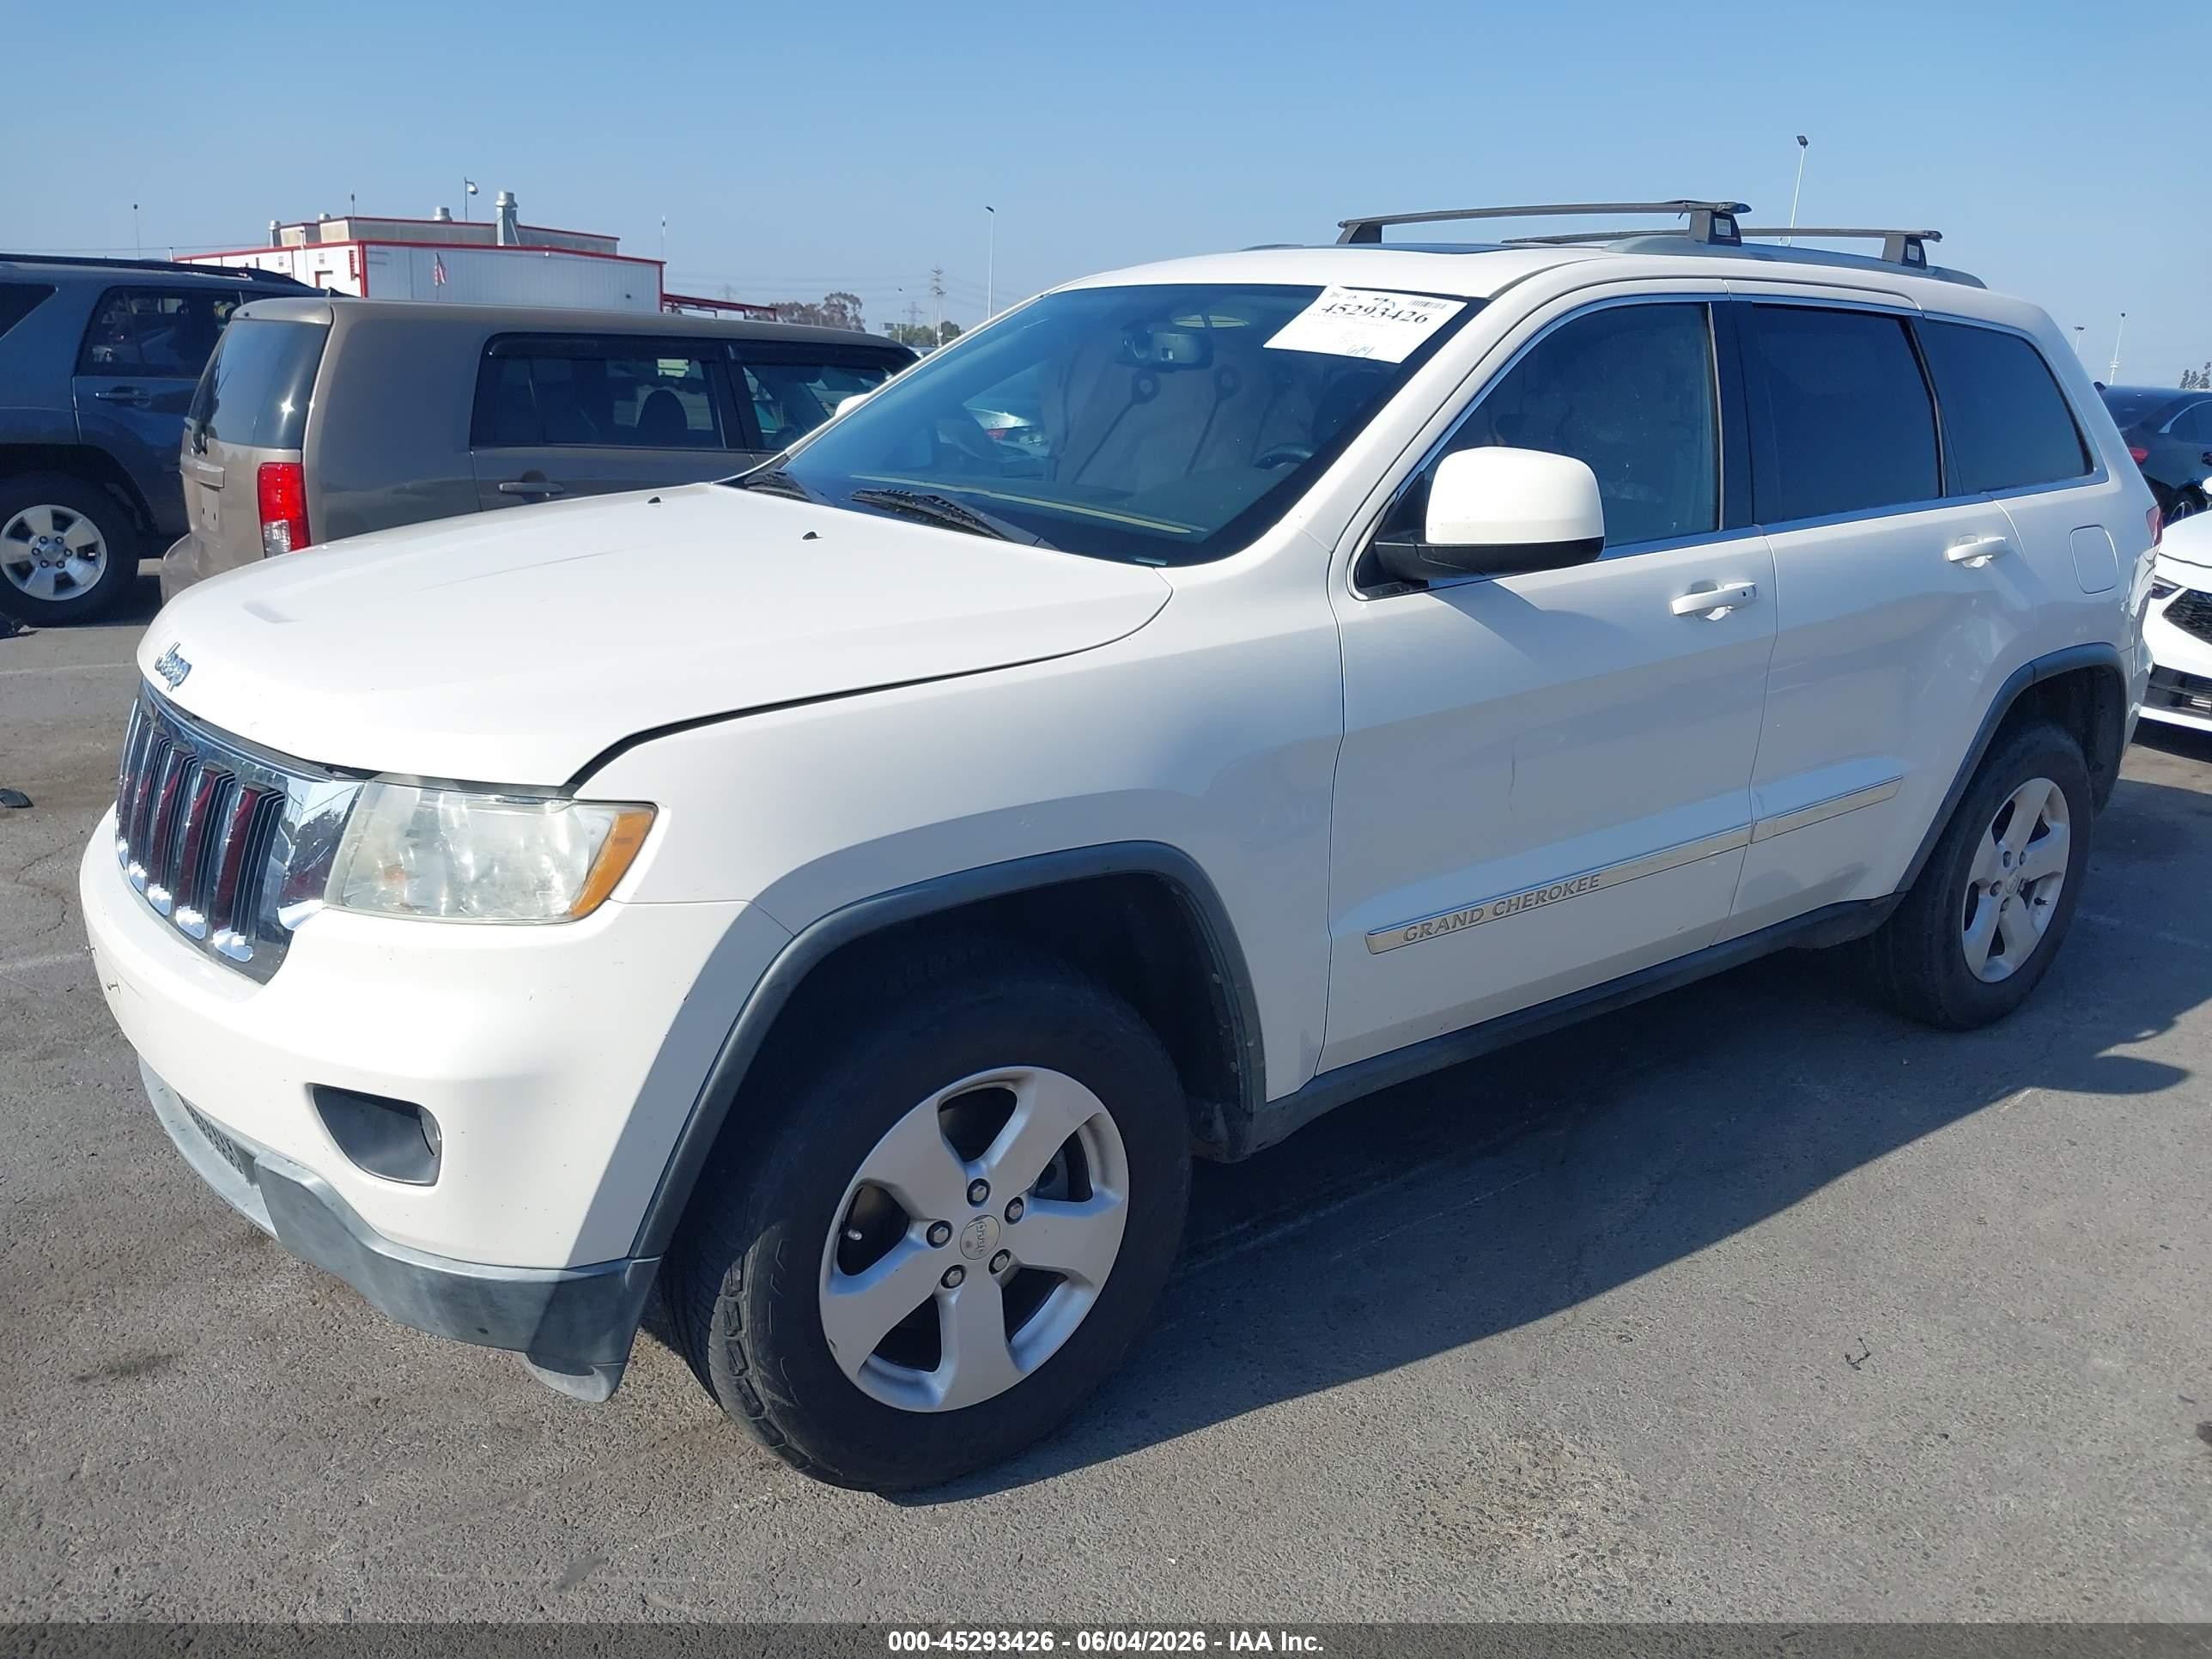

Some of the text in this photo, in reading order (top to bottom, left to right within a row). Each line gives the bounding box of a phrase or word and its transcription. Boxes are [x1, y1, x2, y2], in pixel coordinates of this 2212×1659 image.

[1321, 302, 1432, 325] 45293426
[1402, 872, 1601, 943] GRAND CHEROKEE
